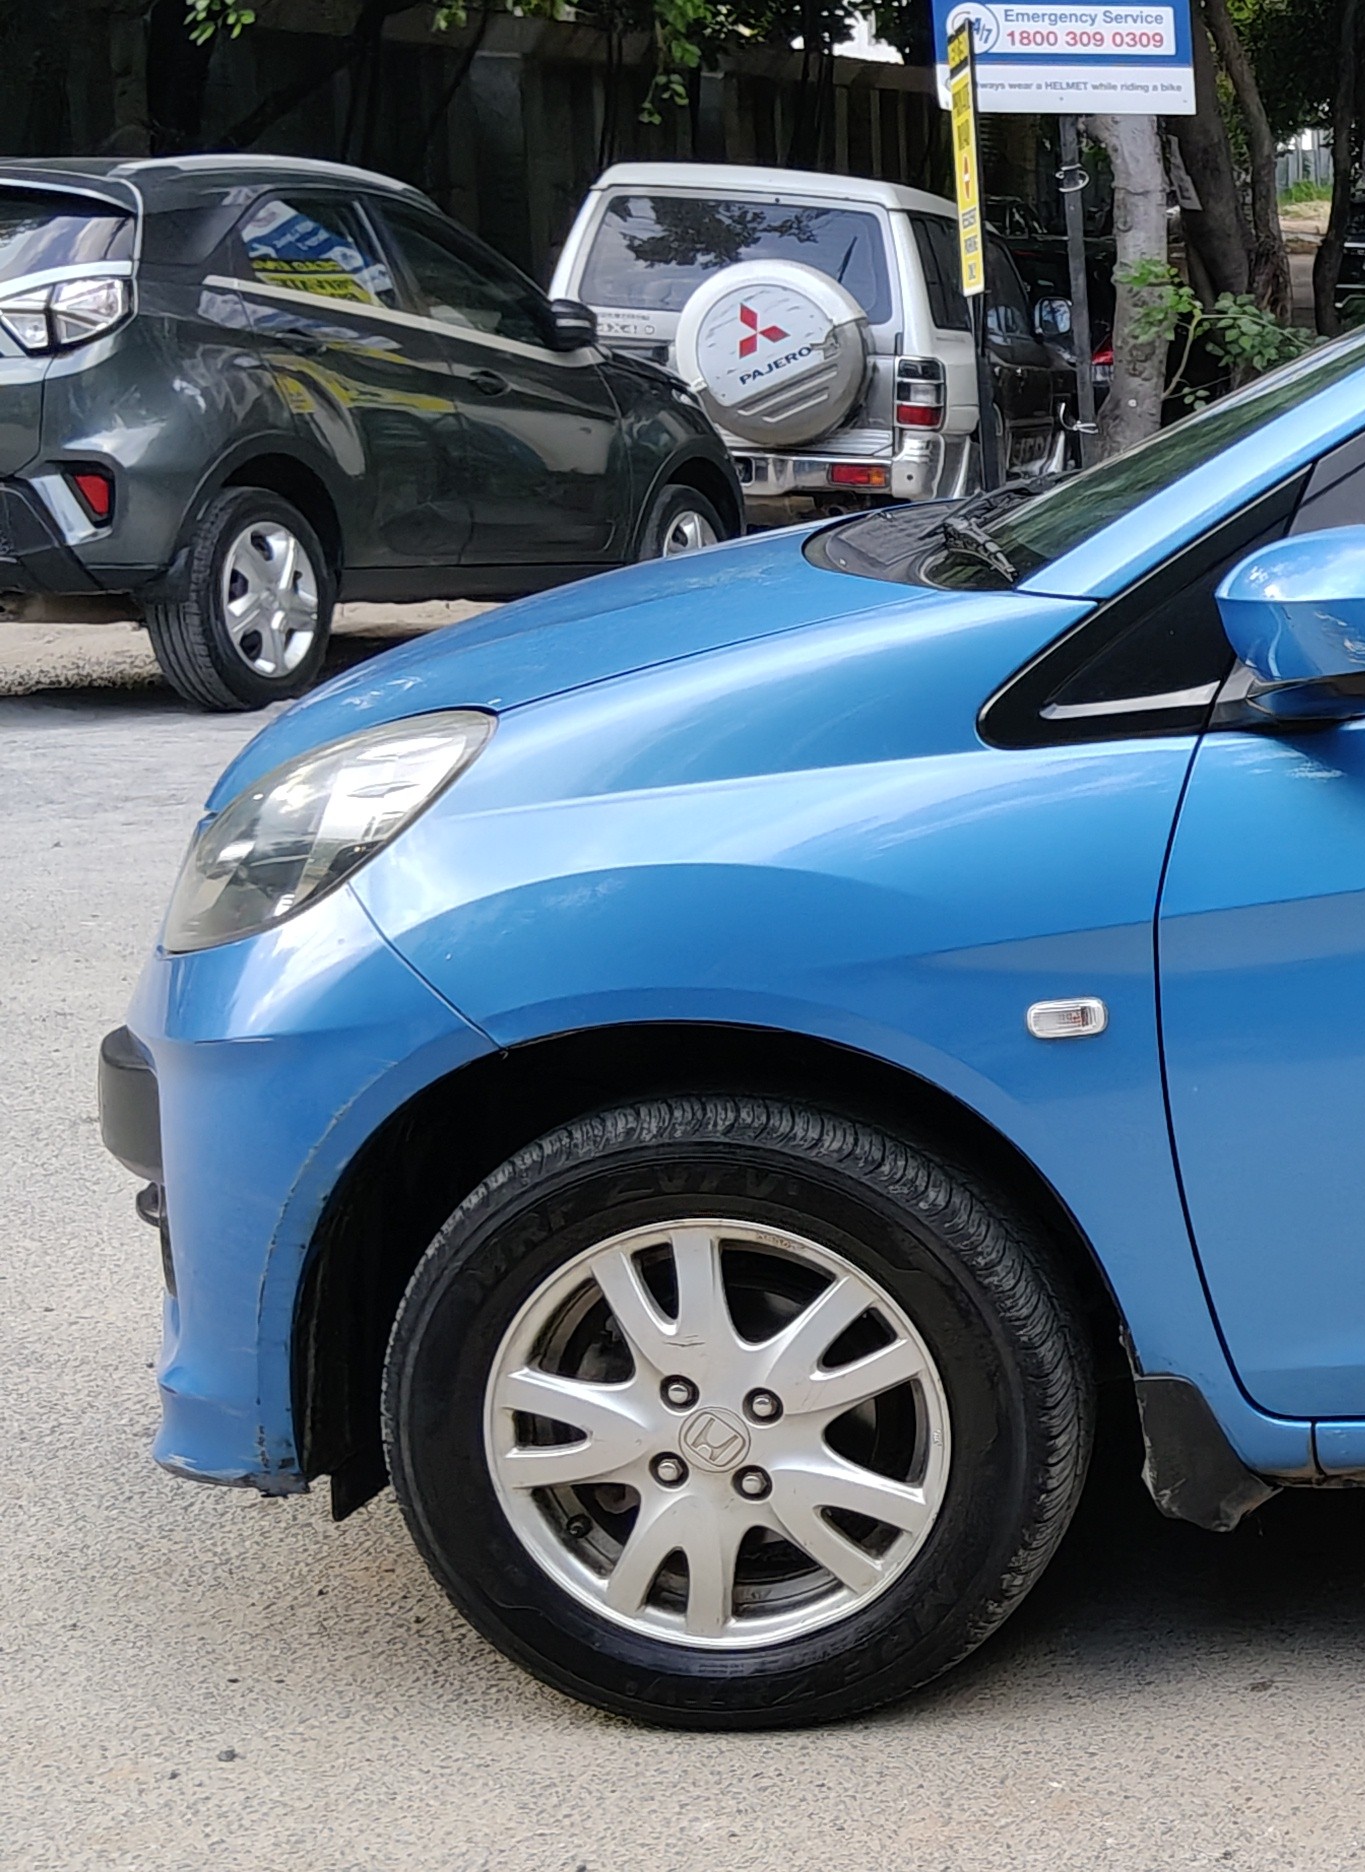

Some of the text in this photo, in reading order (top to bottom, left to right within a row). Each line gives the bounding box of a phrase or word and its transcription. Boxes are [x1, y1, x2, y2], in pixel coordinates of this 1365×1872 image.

[1004, 9, 1164, 26] Emergency Service
[1007, 31, 1164, 48] 1800 309 0309
[1008, 82, 1033, 90] wear
[1045, 81, 1088, 91] HELMET
[1091, 82, 1117, 91] while
[1120, 82, 1149, 93] riding
[1160, 83, 1182, 92] bike
[739, 346, 812, 386] PAJERO
